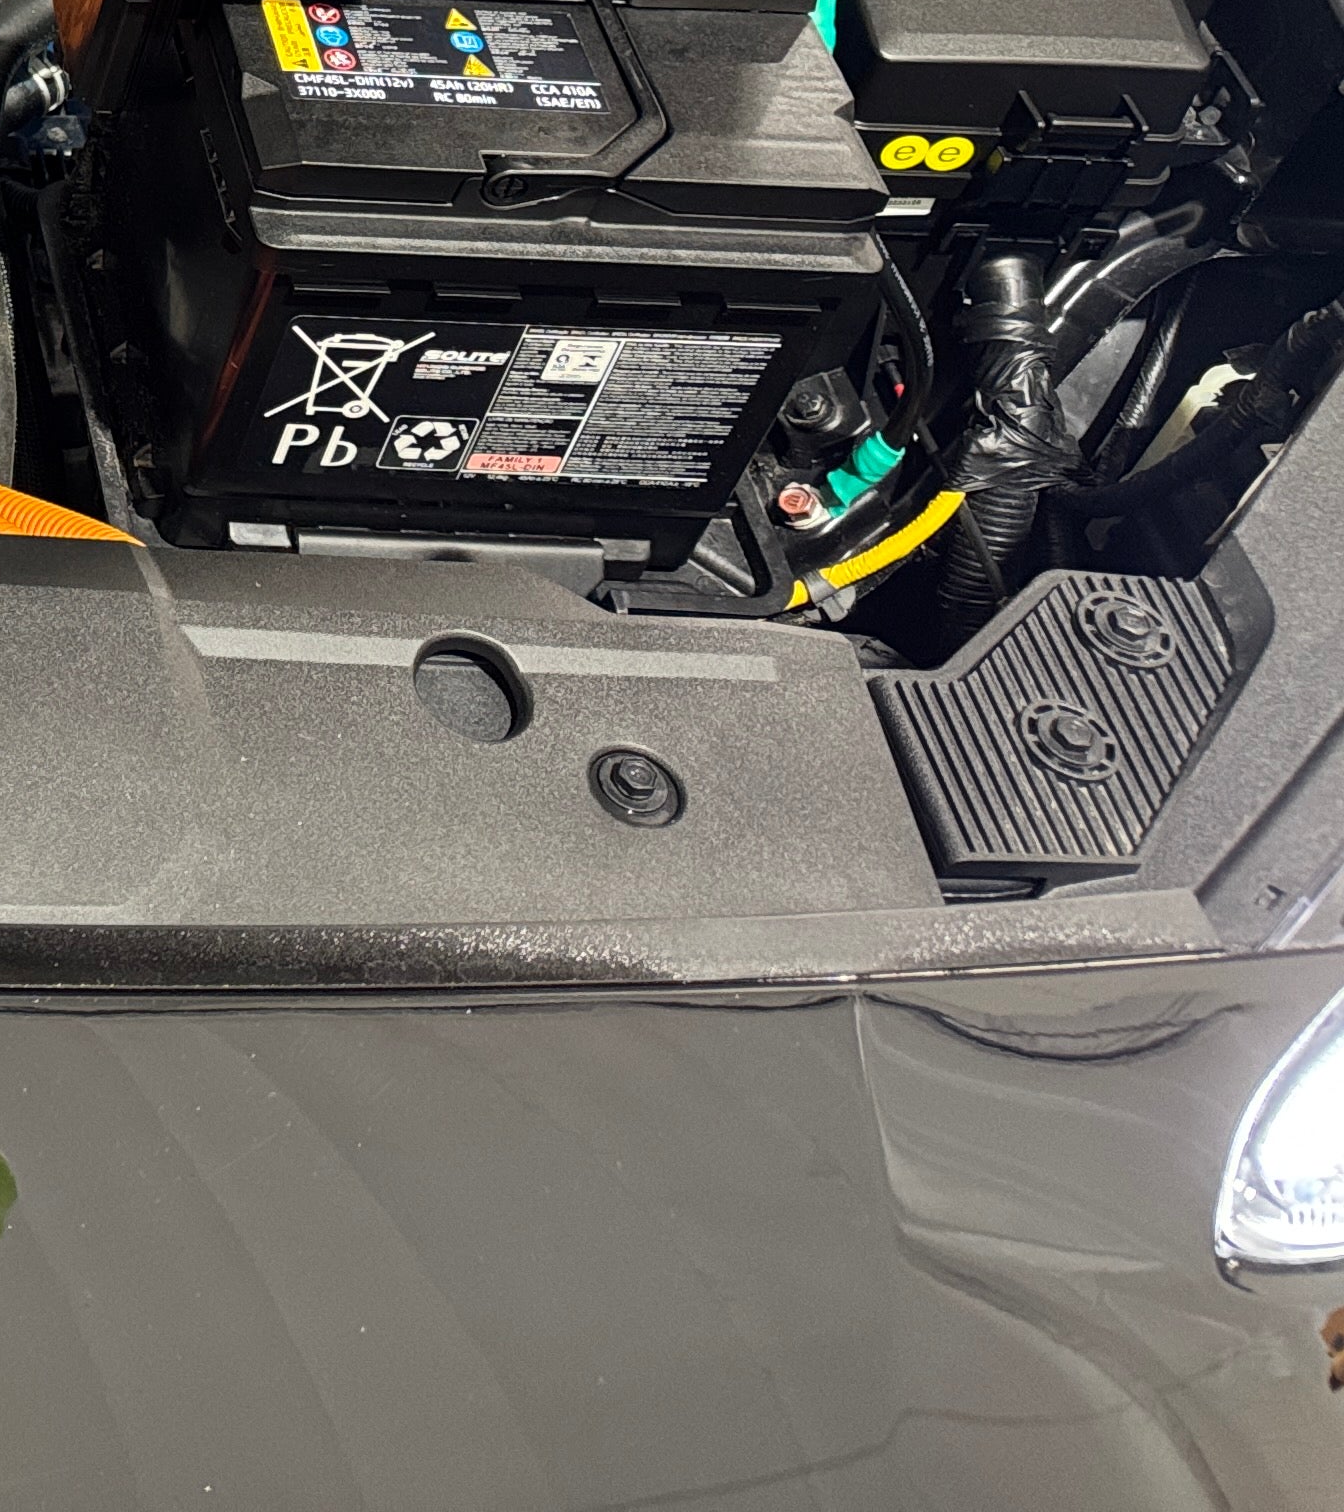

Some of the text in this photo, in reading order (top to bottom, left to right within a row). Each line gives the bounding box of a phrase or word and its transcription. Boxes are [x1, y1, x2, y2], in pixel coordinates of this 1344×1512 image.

[429, 78, 515, 94] 45Ah (20HR)
[530, 83, 598, 97] CCA 410A
[433, 91, 454, 104] RC
[271, 422, 359, 468] Pb
[487, 455, 533, 464] FAMILY
